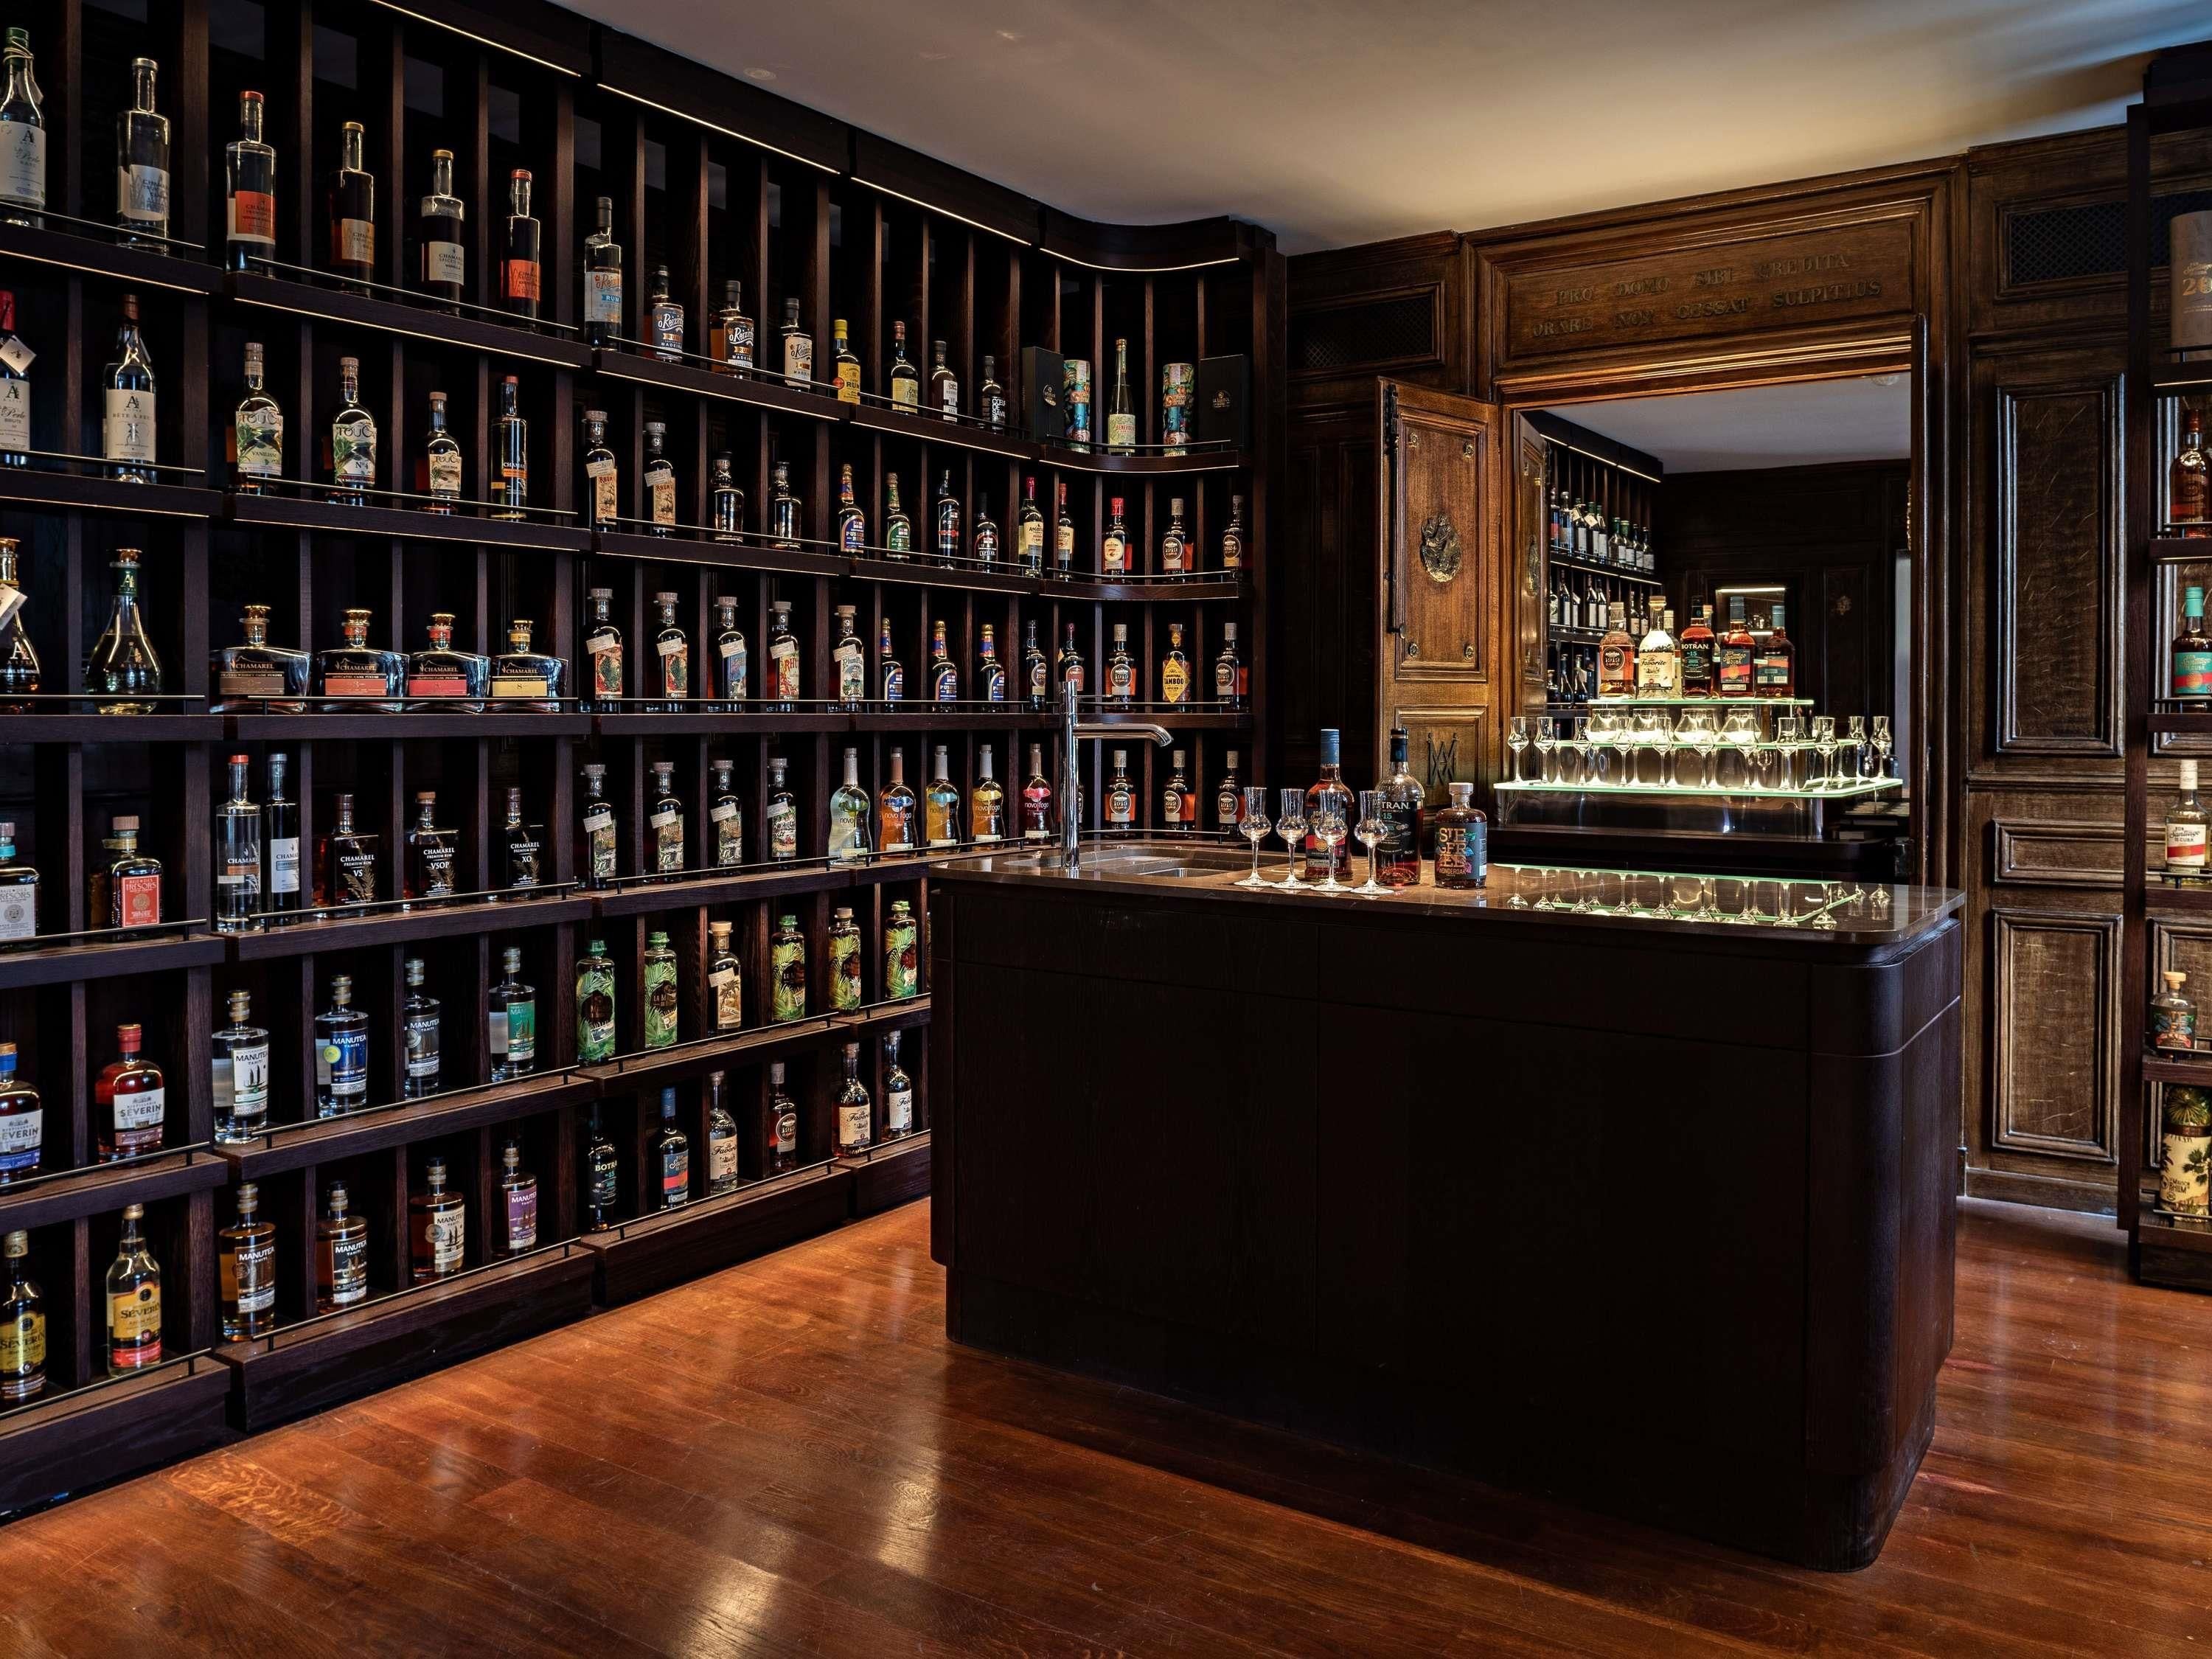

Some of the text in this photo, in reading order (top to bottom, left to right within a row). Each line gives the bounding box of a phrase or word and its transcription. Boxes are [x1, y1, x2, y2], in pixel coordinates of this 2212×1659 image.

[1557, 288, 1593, 305] PRO
[1617, 277, 1669, 296] DOMO
[1694, 267, 1733, 287] SIBI
[1676, 296, 1749, 320] CESSAT
[1772, 276, 1882, 308] SULPITIUS
[990, 804, 1000, 813] fogo
[1038, 801, 1049, 810] fogo
[900, 812, 912, 821] fogo
[2169, 830, 2200, 839] Santiago
[510, 842, 540, 850] CHAMAREL
[423, 848, 455, 856] CHAMAREL
[340, 854, 375, 863] CHAMAREL
[522, 855, 532, 863] XO
[431, 862, 450, 870] VSOP
[354, 869, 364, 877] VS
